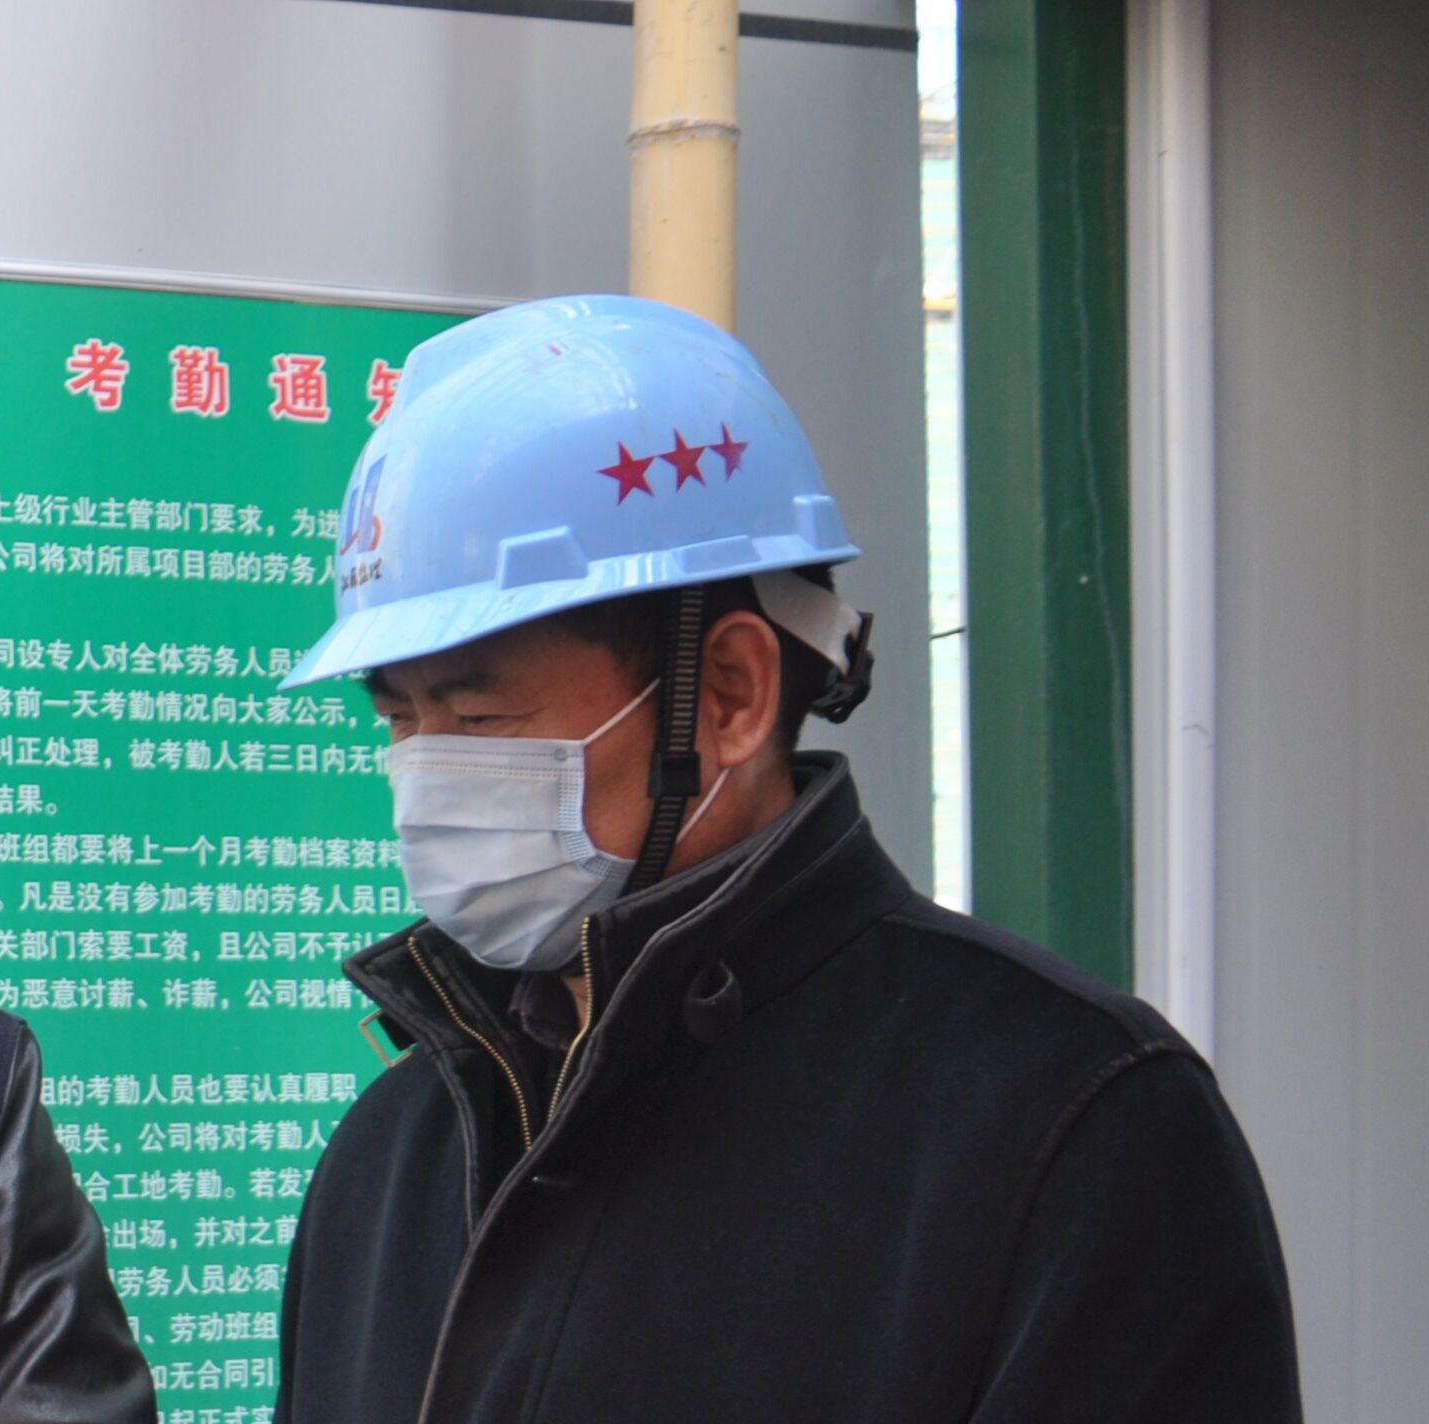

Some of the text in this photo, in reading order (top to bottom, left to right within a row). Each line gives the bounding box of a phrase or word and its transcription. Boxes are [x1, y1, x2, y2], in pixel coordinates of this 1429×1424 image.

[53, 1119, 340, 1153] 损失，公司将对考勤人
[72, 1167, 315, 1202] 合工地考勤。若发
[103, 1215, 298, 1250] 出场，并对之前
[108, 1263, 287, 1297] 劳务人员必须
